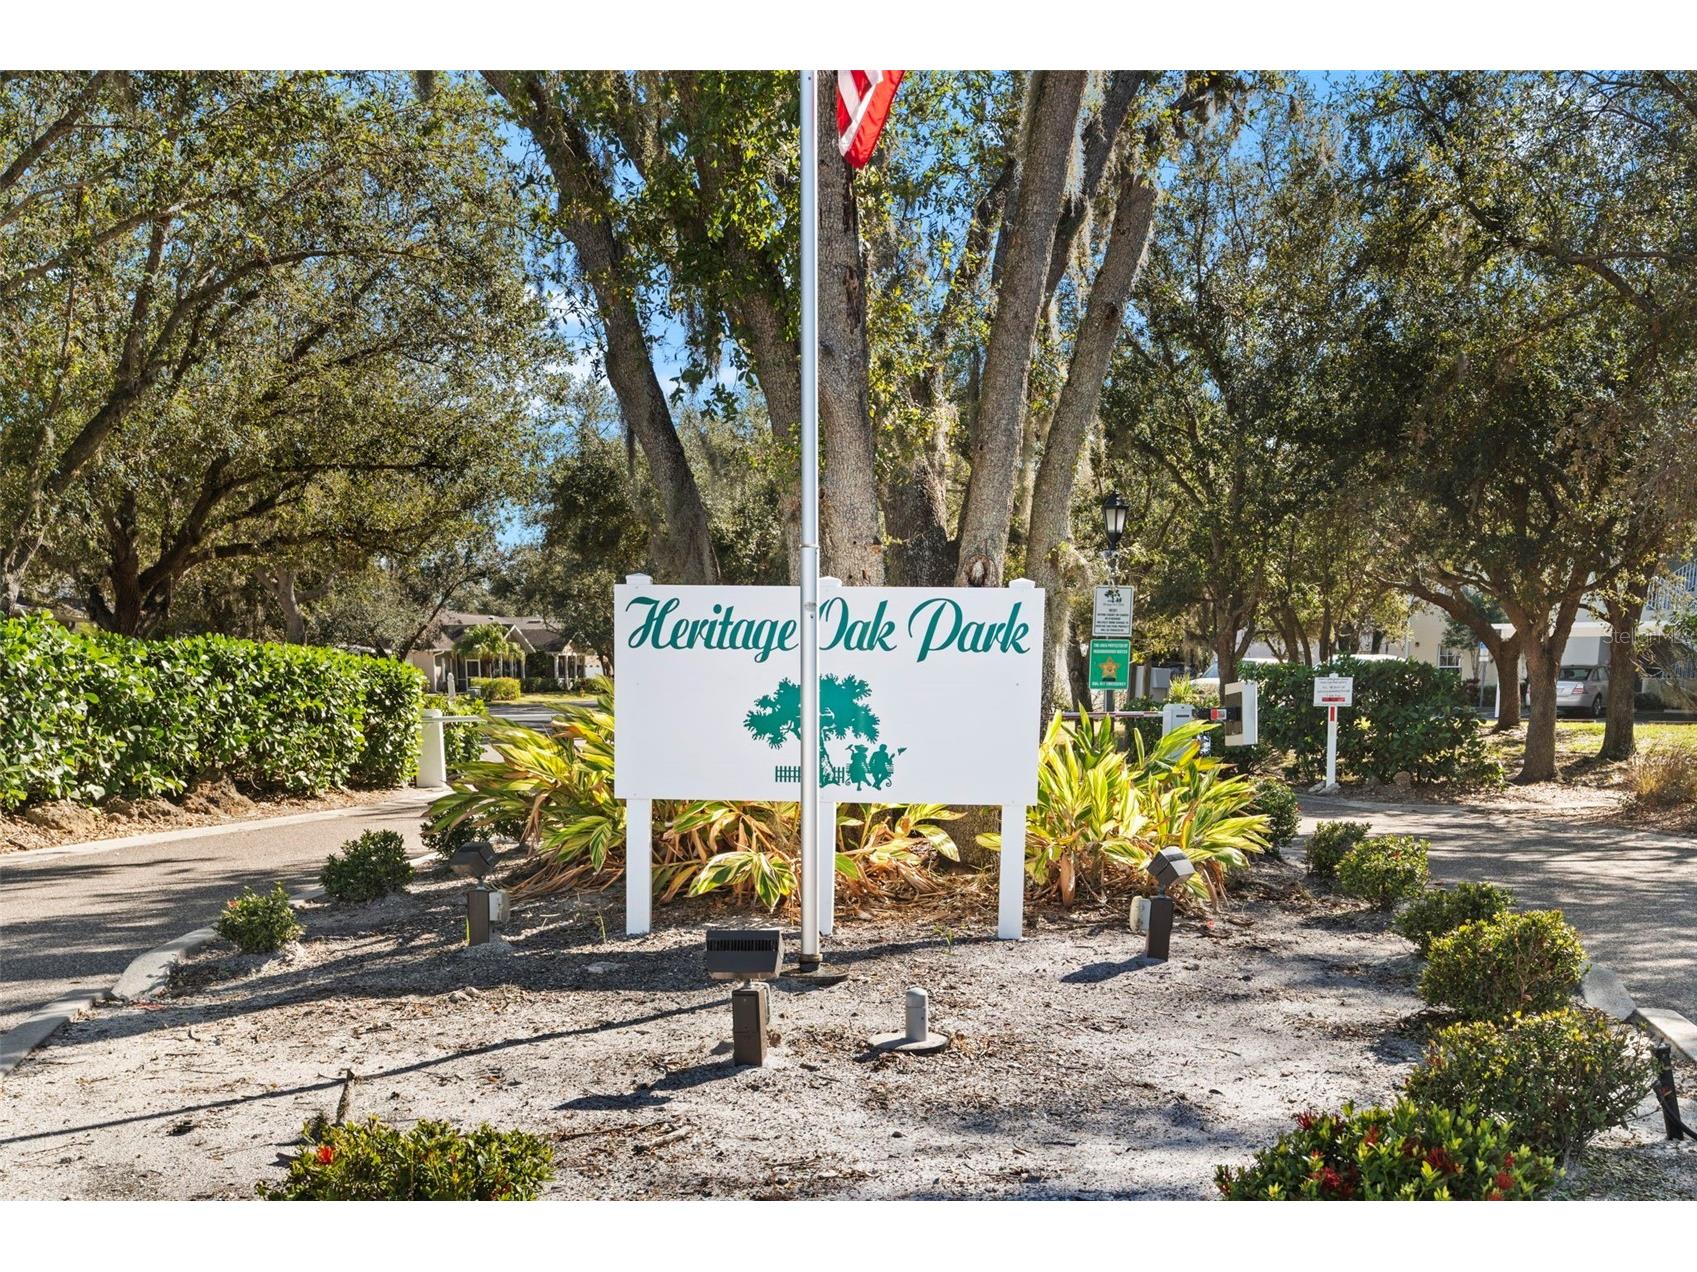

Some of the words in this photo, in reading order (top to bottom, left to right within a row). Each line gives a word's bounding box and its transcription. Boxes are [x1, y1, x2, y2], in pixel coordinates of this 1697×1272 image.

[625, 596, 800, 663] Heritage
[818, 597, 897, 652] Oak
[907, 598, 1031, 663] Park
